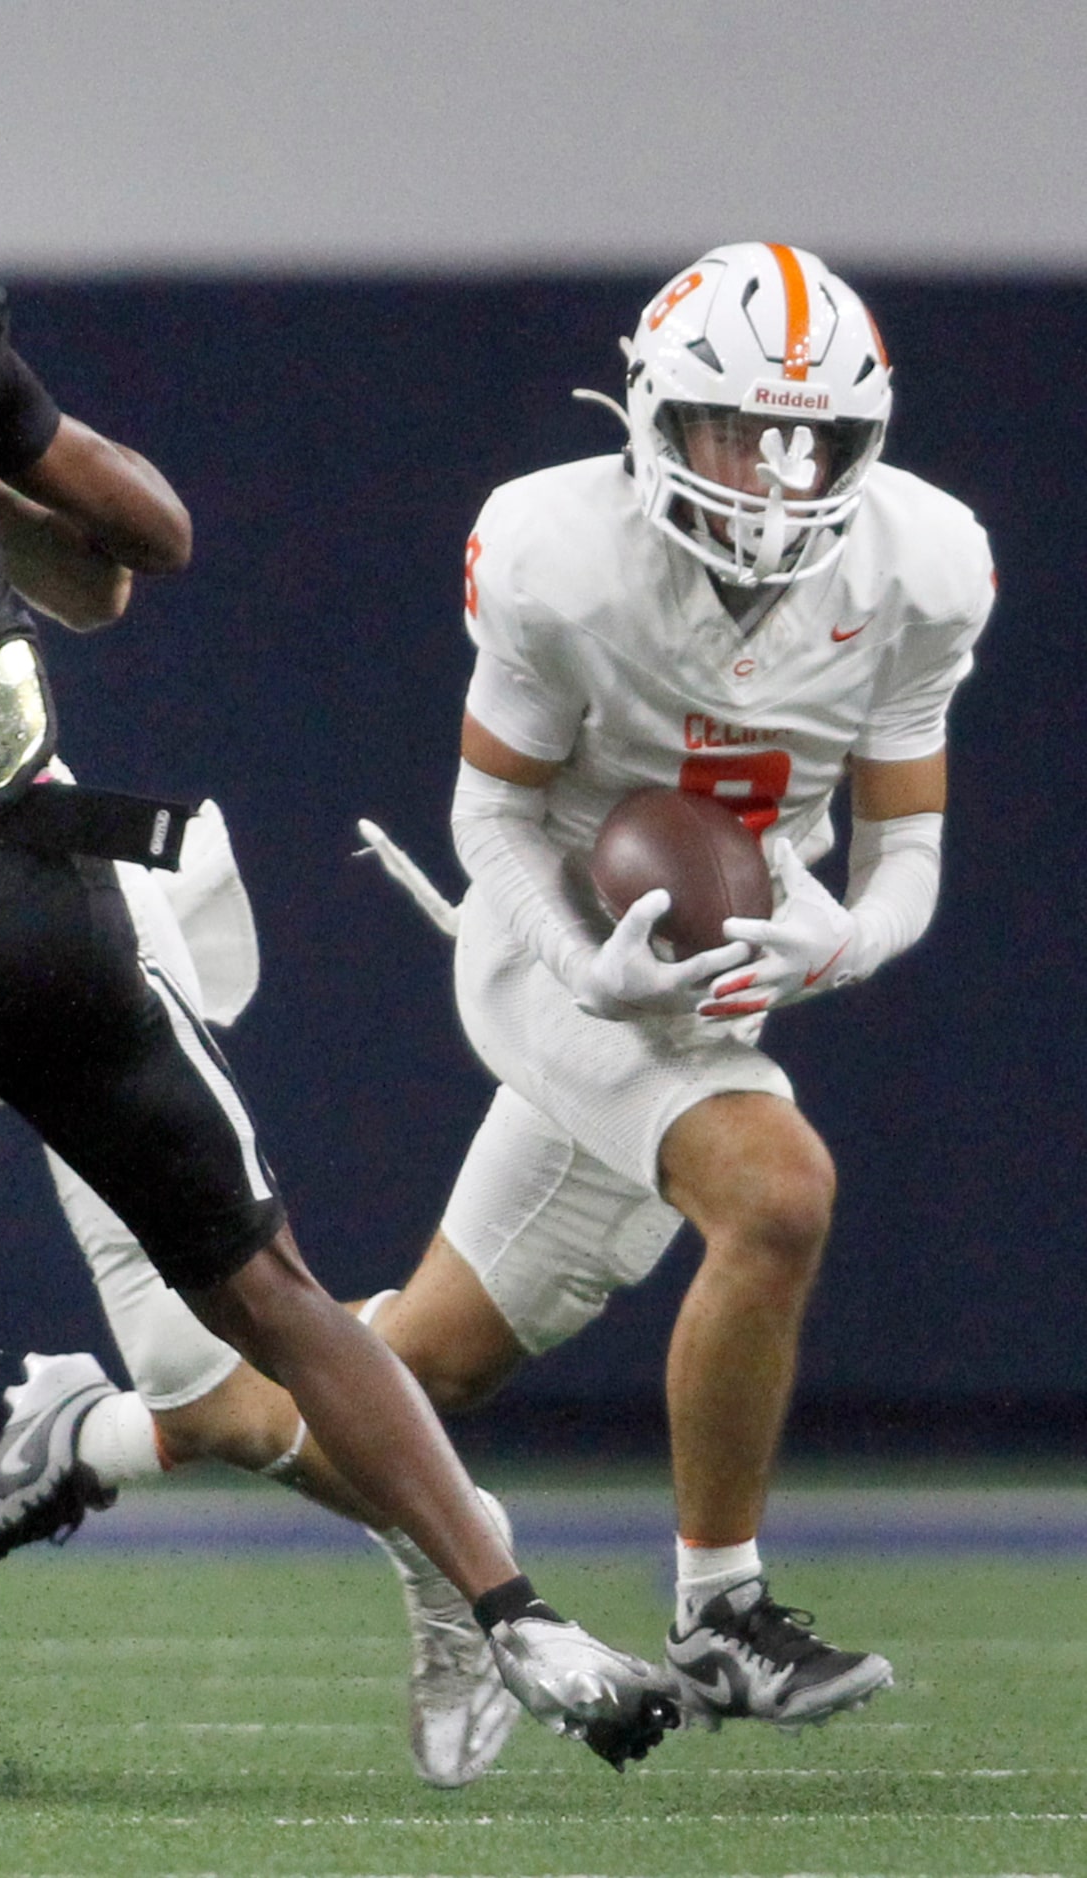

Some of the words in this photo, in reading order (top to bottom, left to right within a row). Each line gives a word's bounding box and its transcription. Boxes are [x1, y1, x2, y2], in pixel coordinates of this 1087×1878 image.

[648, 271, 704, 332] 8
[755, 387, 831, 410] Riddell
[733, 658, 756, 677] C
